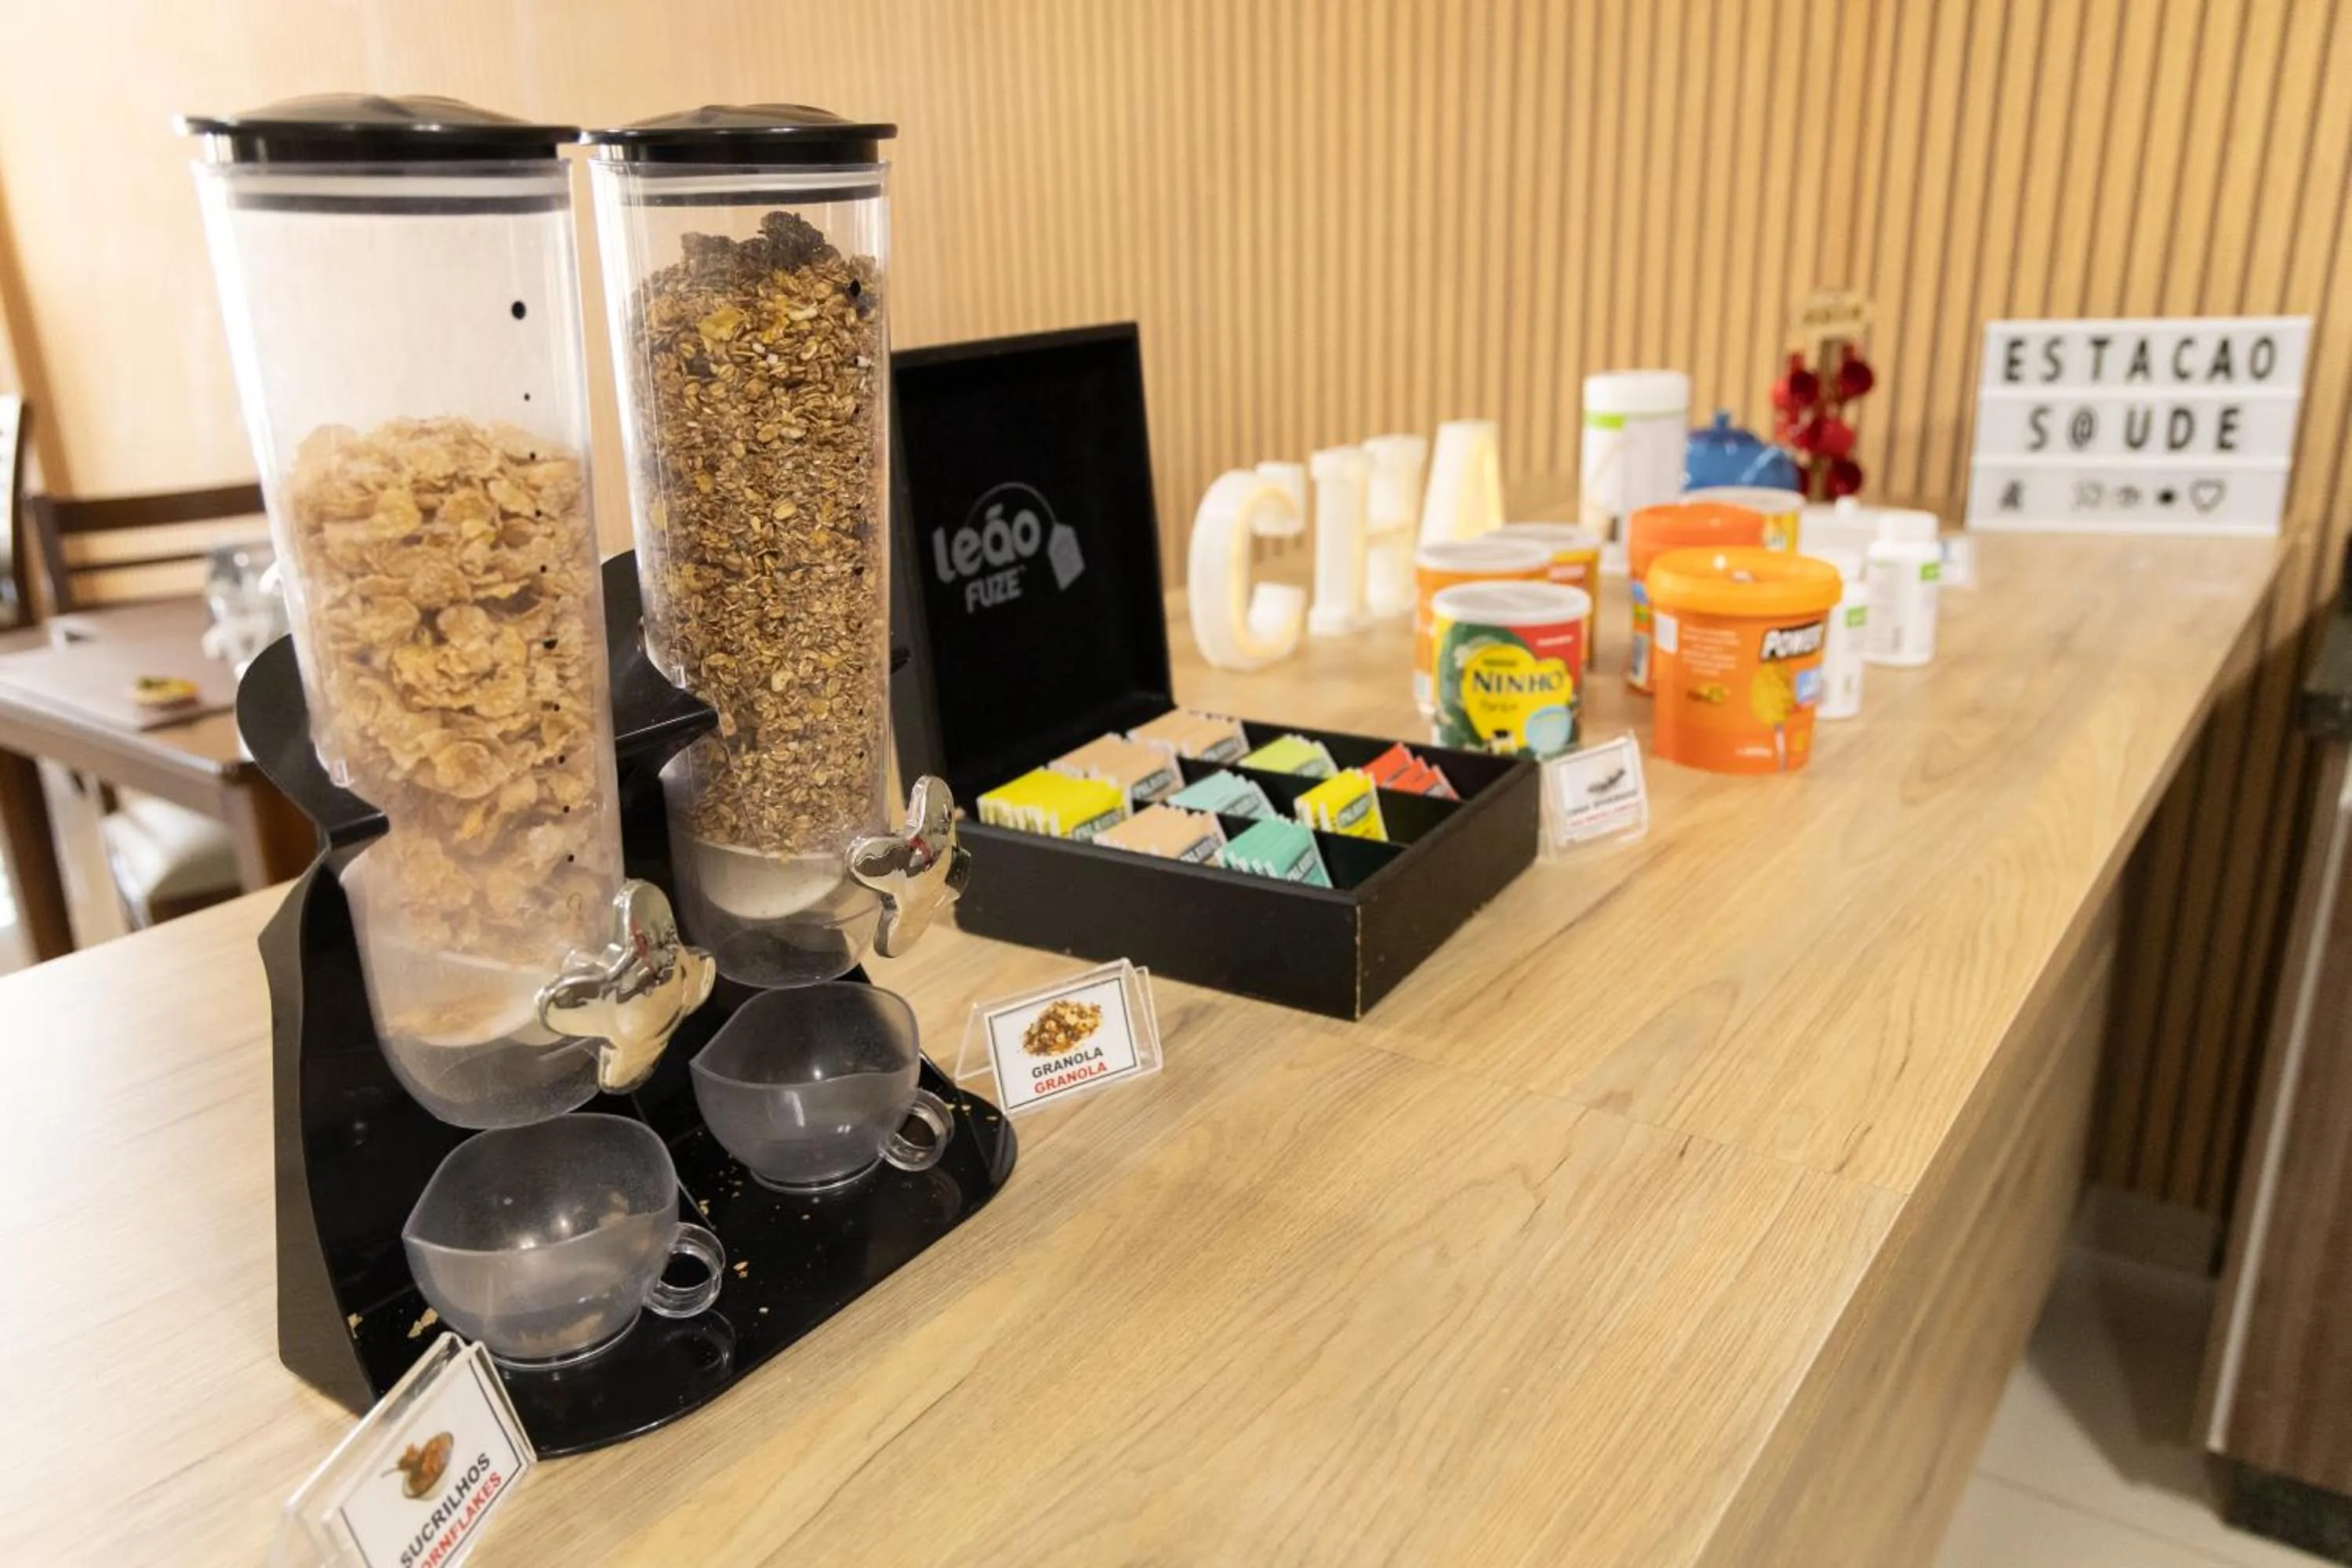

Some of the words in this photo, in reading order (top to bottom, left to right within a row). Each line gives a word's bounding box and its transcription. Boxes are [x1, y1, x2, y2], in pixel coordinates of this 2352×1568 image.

[2002, 336, 2277, 383] ESTACAO
[965, 568, 1024, 614] FUZE
[1473, 670, 1563, 692] NINHO
[1032, 1047, 1104, 1078] GRANOLA
[1034, 1062, 1108, 1094] GRANOLA
[400, 1452, 491, 1568] SUCRILHOS
[419, 1471, 503, 1568] ORNFLAKES
